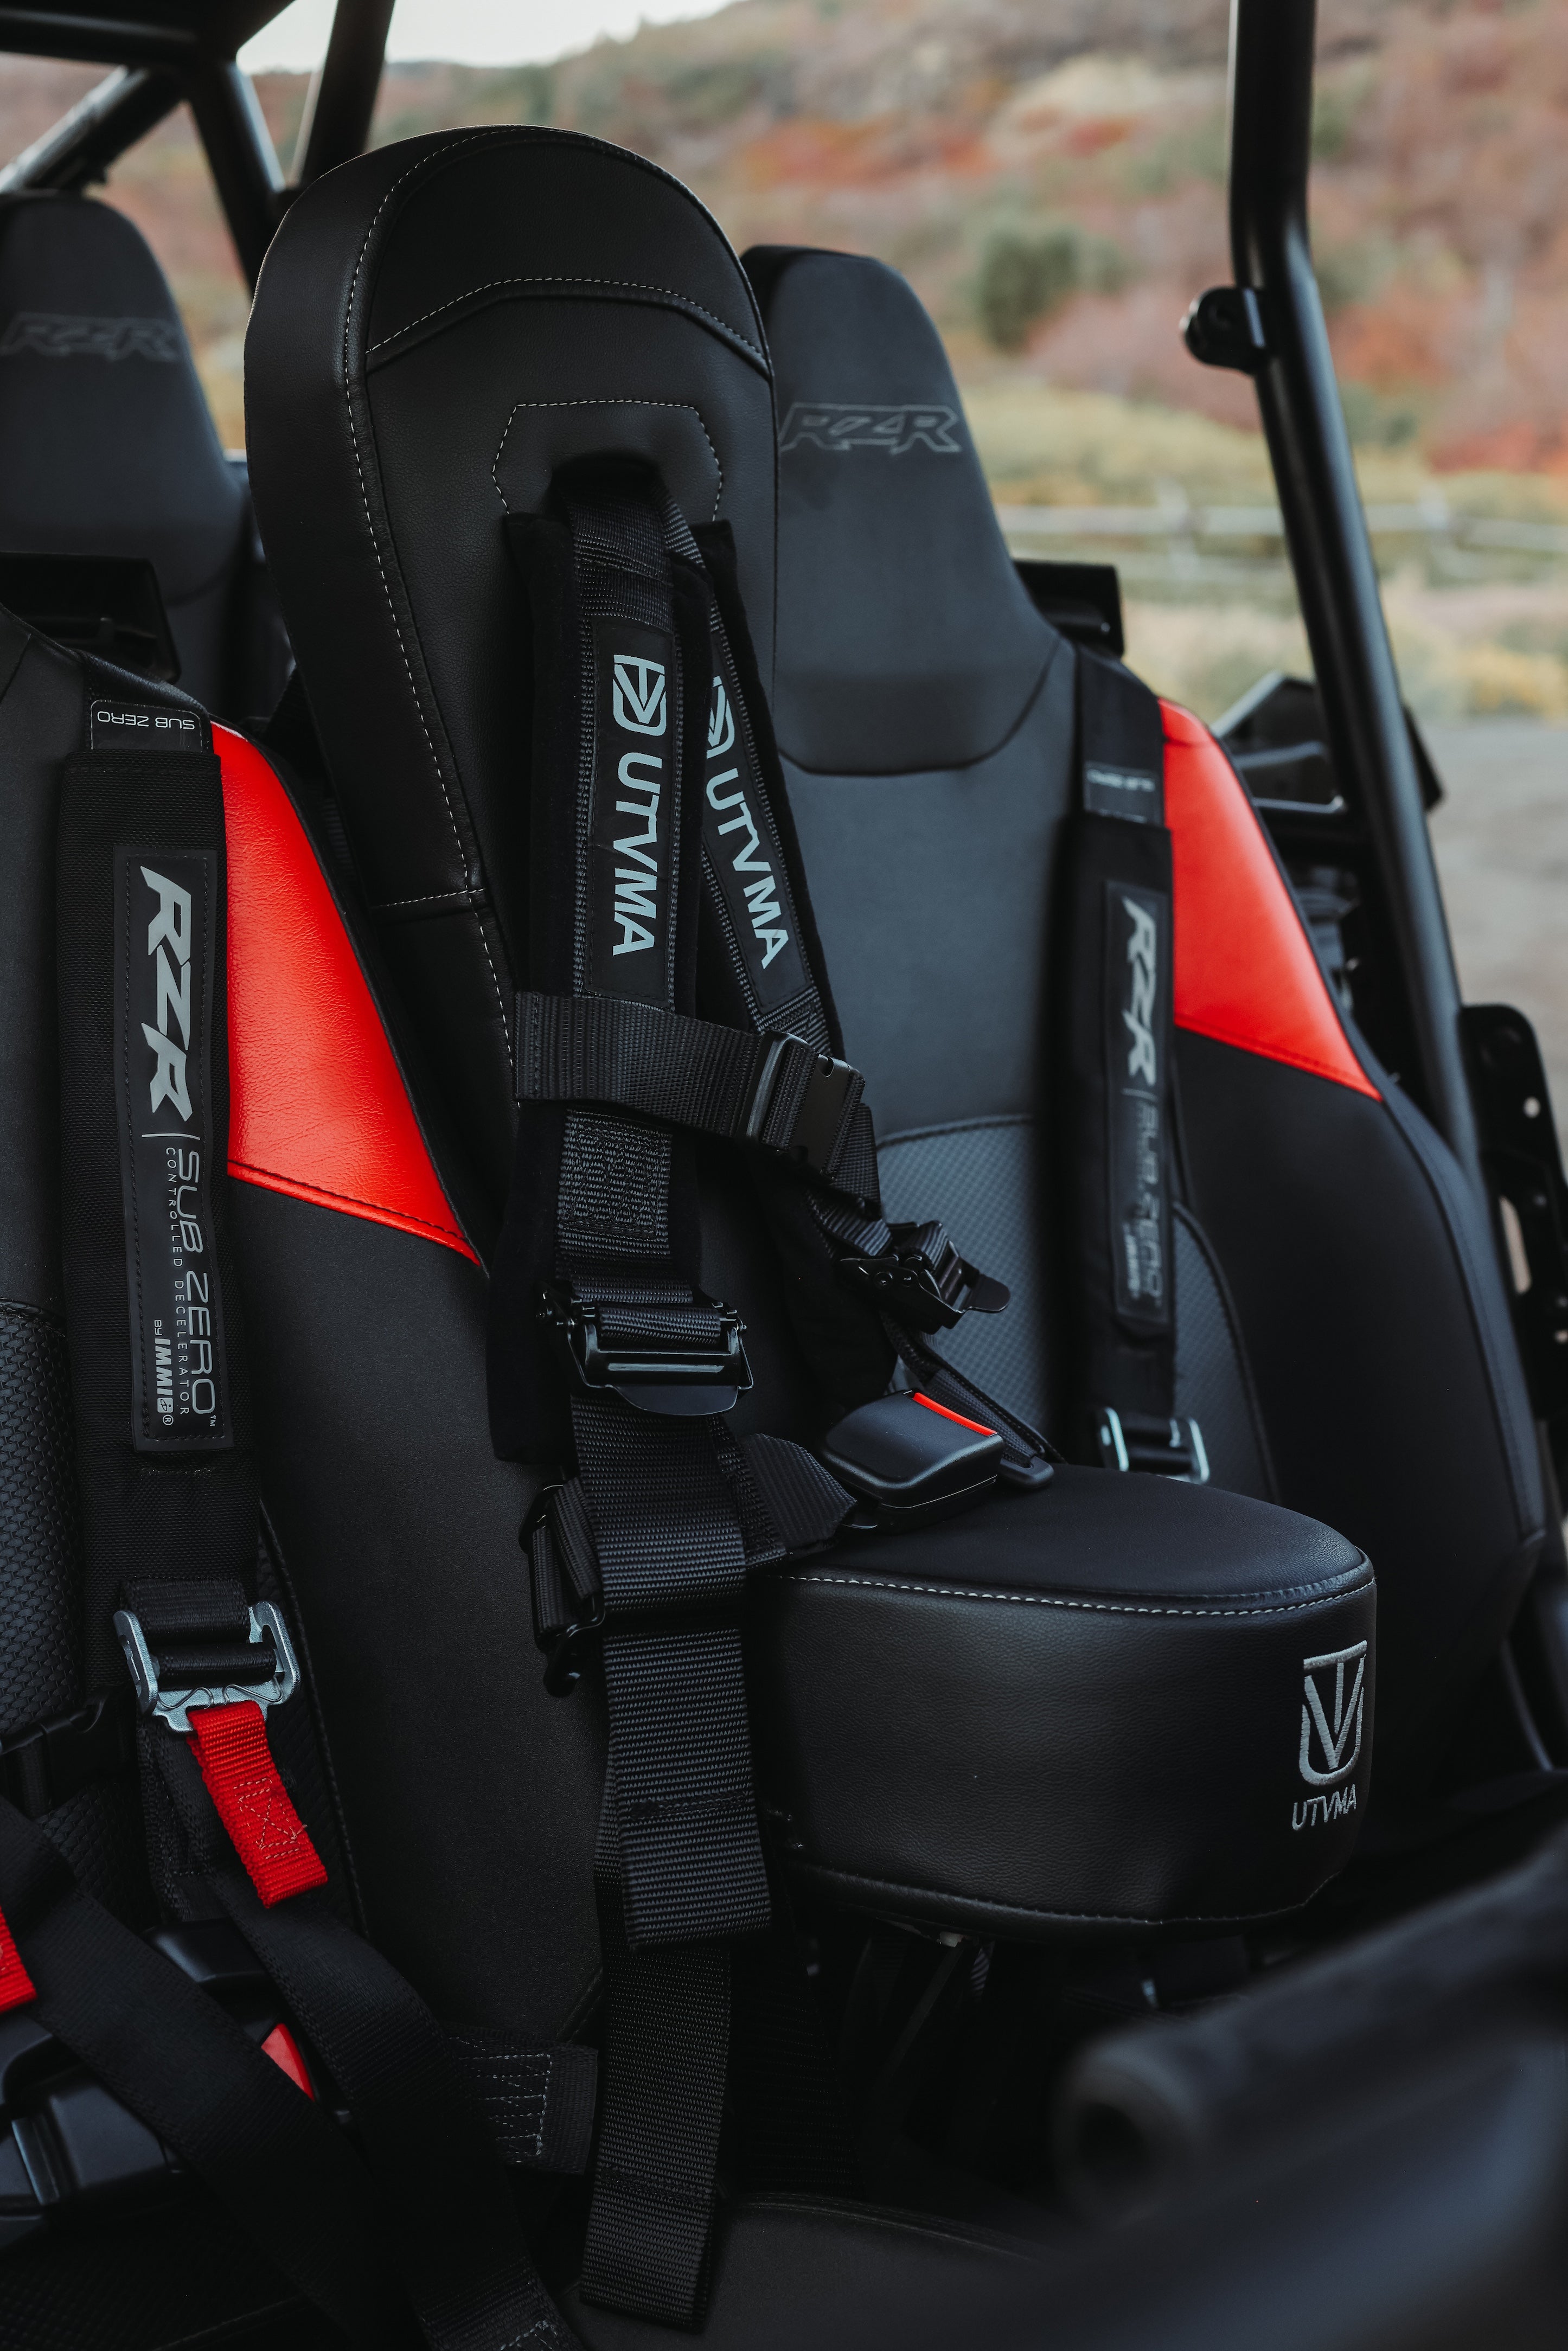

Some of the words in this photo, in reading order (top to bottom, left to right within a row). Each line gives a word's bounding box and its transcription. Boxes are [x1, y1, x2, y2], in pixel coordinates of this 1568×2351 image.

[777, 401, 962, 454] RZR
[97, 710, 150, 727] ZERO
[155, 716, 196, 731] SUB
[613, 752, 662, 956] UTVMA
[706, 768, 789, 969] UTVMA
[140, 866, 193, 1122] RZR
[1121, 895, 1156, 1085] RZR
[177, 1148, 203, 1253] SUB
[165, 1147, 183, 1267] CONTROLLED
[174, 1280, 190, 1415] DECELERATOR
[1291, 1783, 1357, 1831] UTVMA
